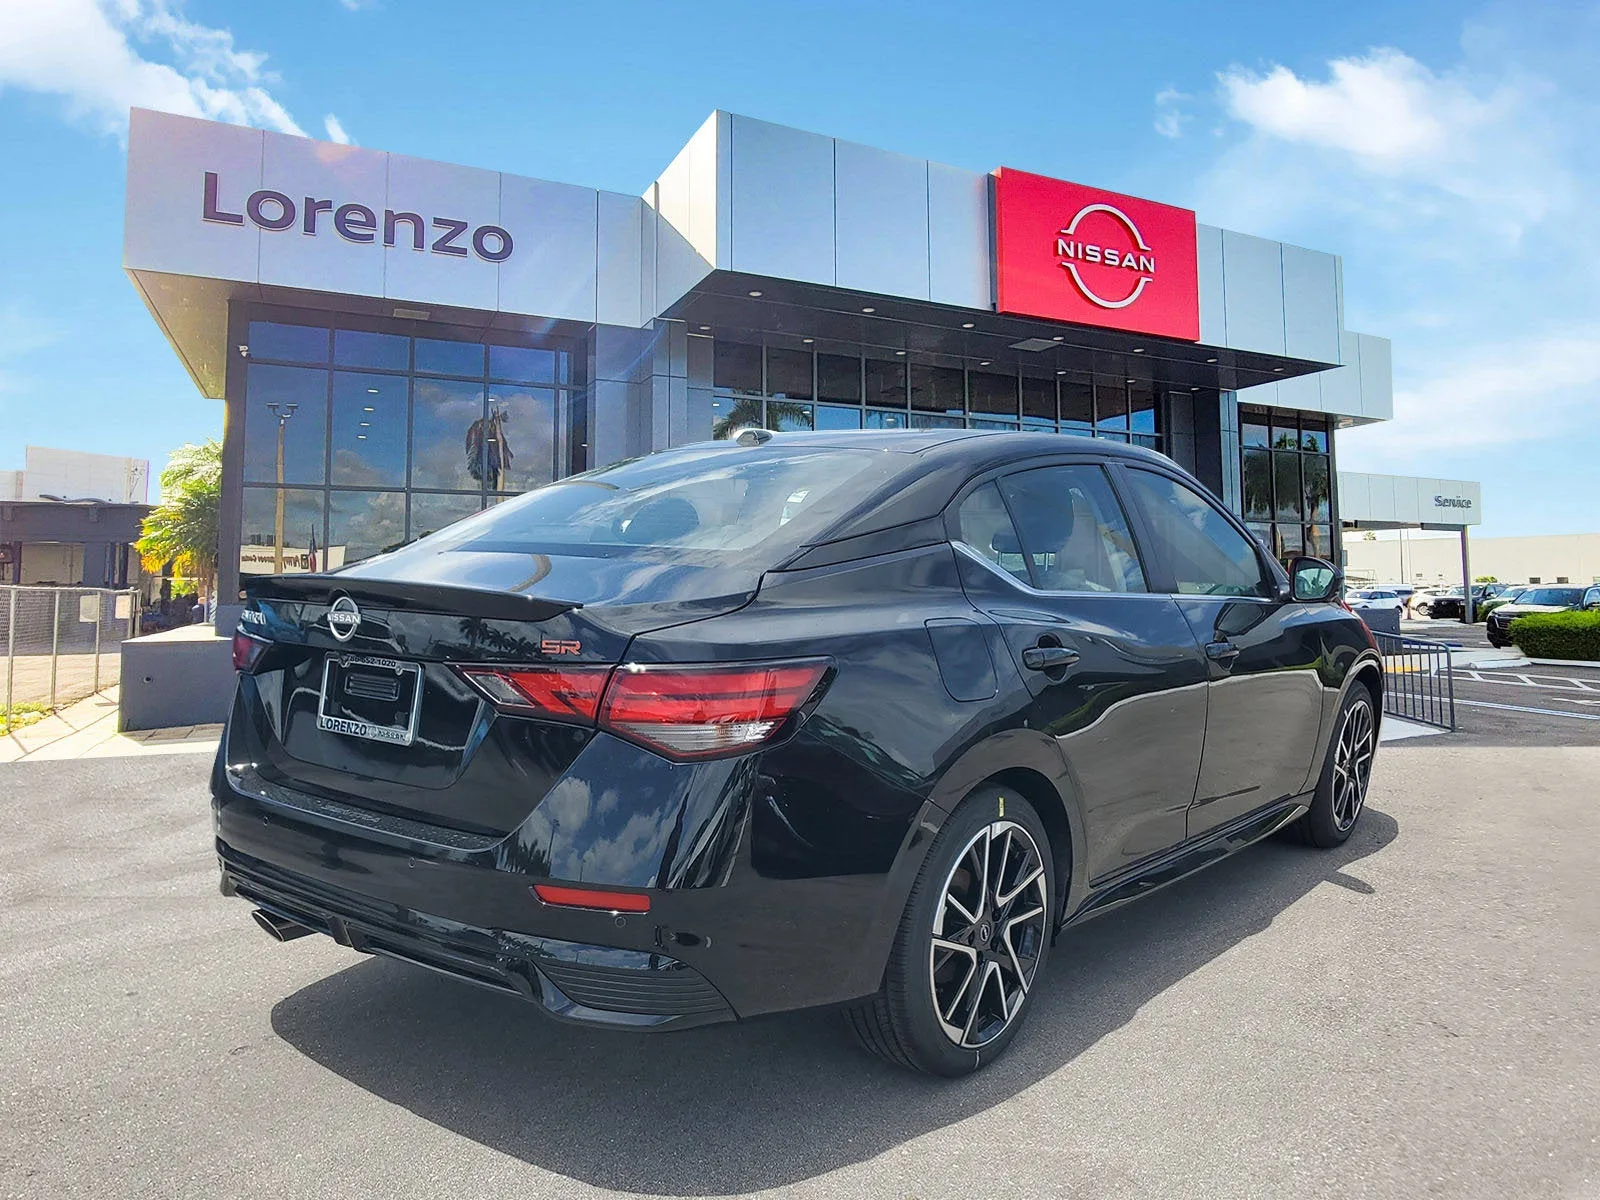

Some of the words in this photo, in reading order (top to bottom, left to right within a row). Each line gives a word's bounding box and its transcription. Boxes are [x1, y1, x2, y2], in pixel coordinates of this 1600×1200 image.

[202, 171, 514, 262] Lorenzo
[1057, 238, 1155, 273] NISSAN
[1434, 495, 1472, 509] Service
[327, 611, 361, 624] NISSAN
[541, 639, 581, 656] SR
[320, 717, 367, 736] LORENZO
[377, 728, 406, 743] NISSAN
